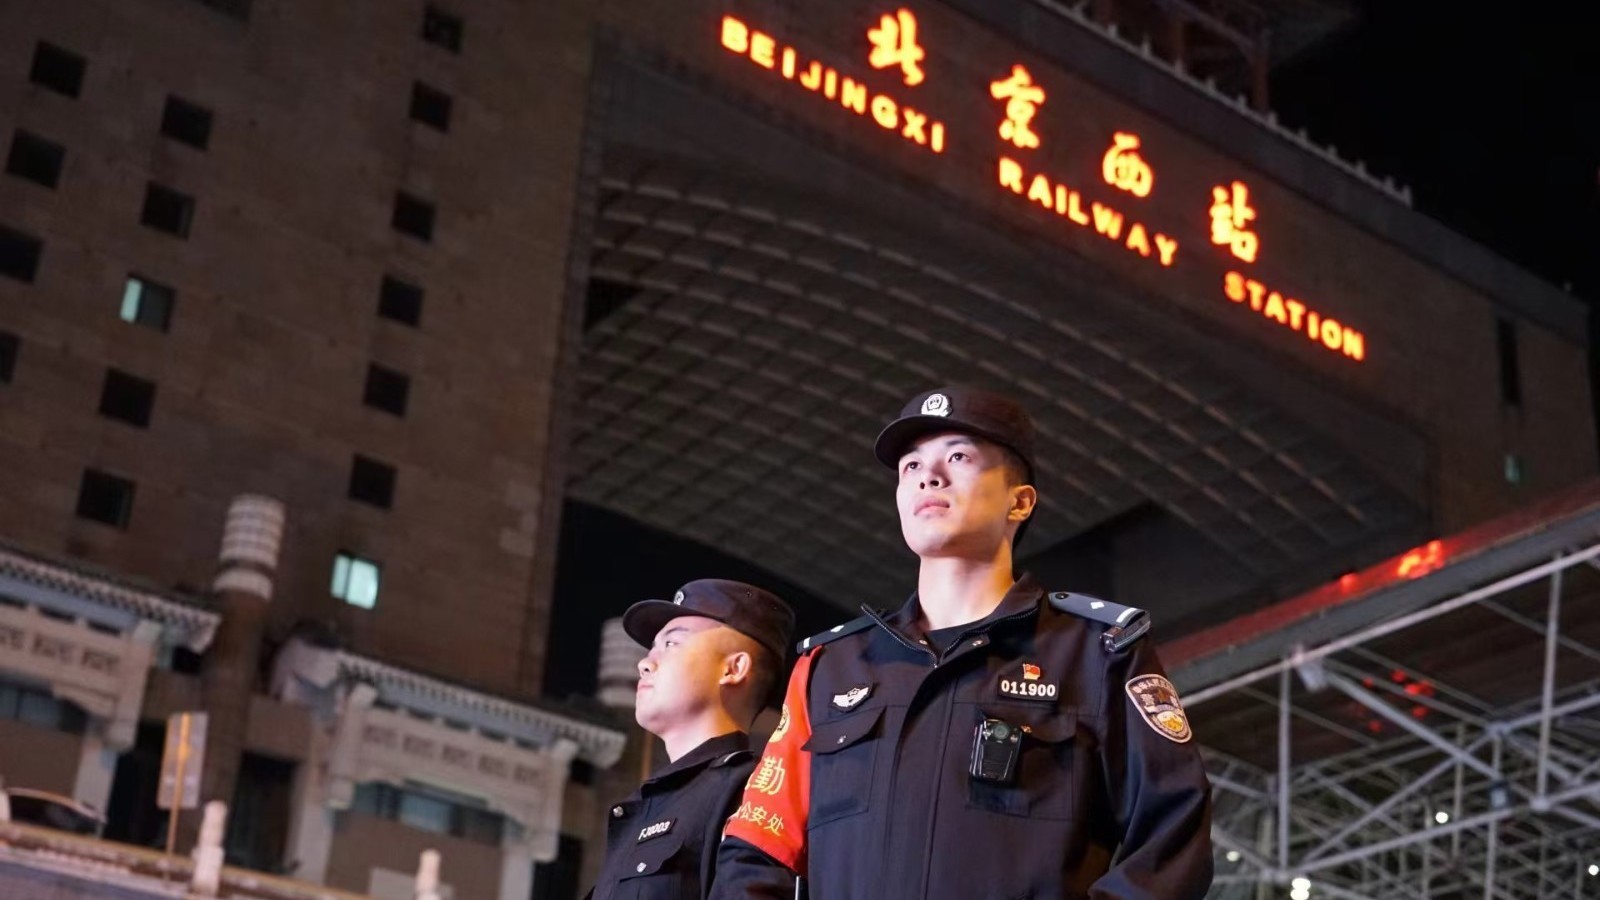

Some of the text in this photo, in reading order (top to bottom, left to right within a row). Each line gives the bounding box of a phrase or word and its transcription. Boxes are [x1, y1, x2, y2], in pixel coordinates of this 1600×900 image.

[866, 8, 1258, 263] 北京西站
[721, 16, 1364, 361] BEIJINGXI RAILWAY STATION
[1001, 679, 1056, 697] 011900
[745, 756, 786, 795] 勤
[736, 801, 784, 836] 公安处
